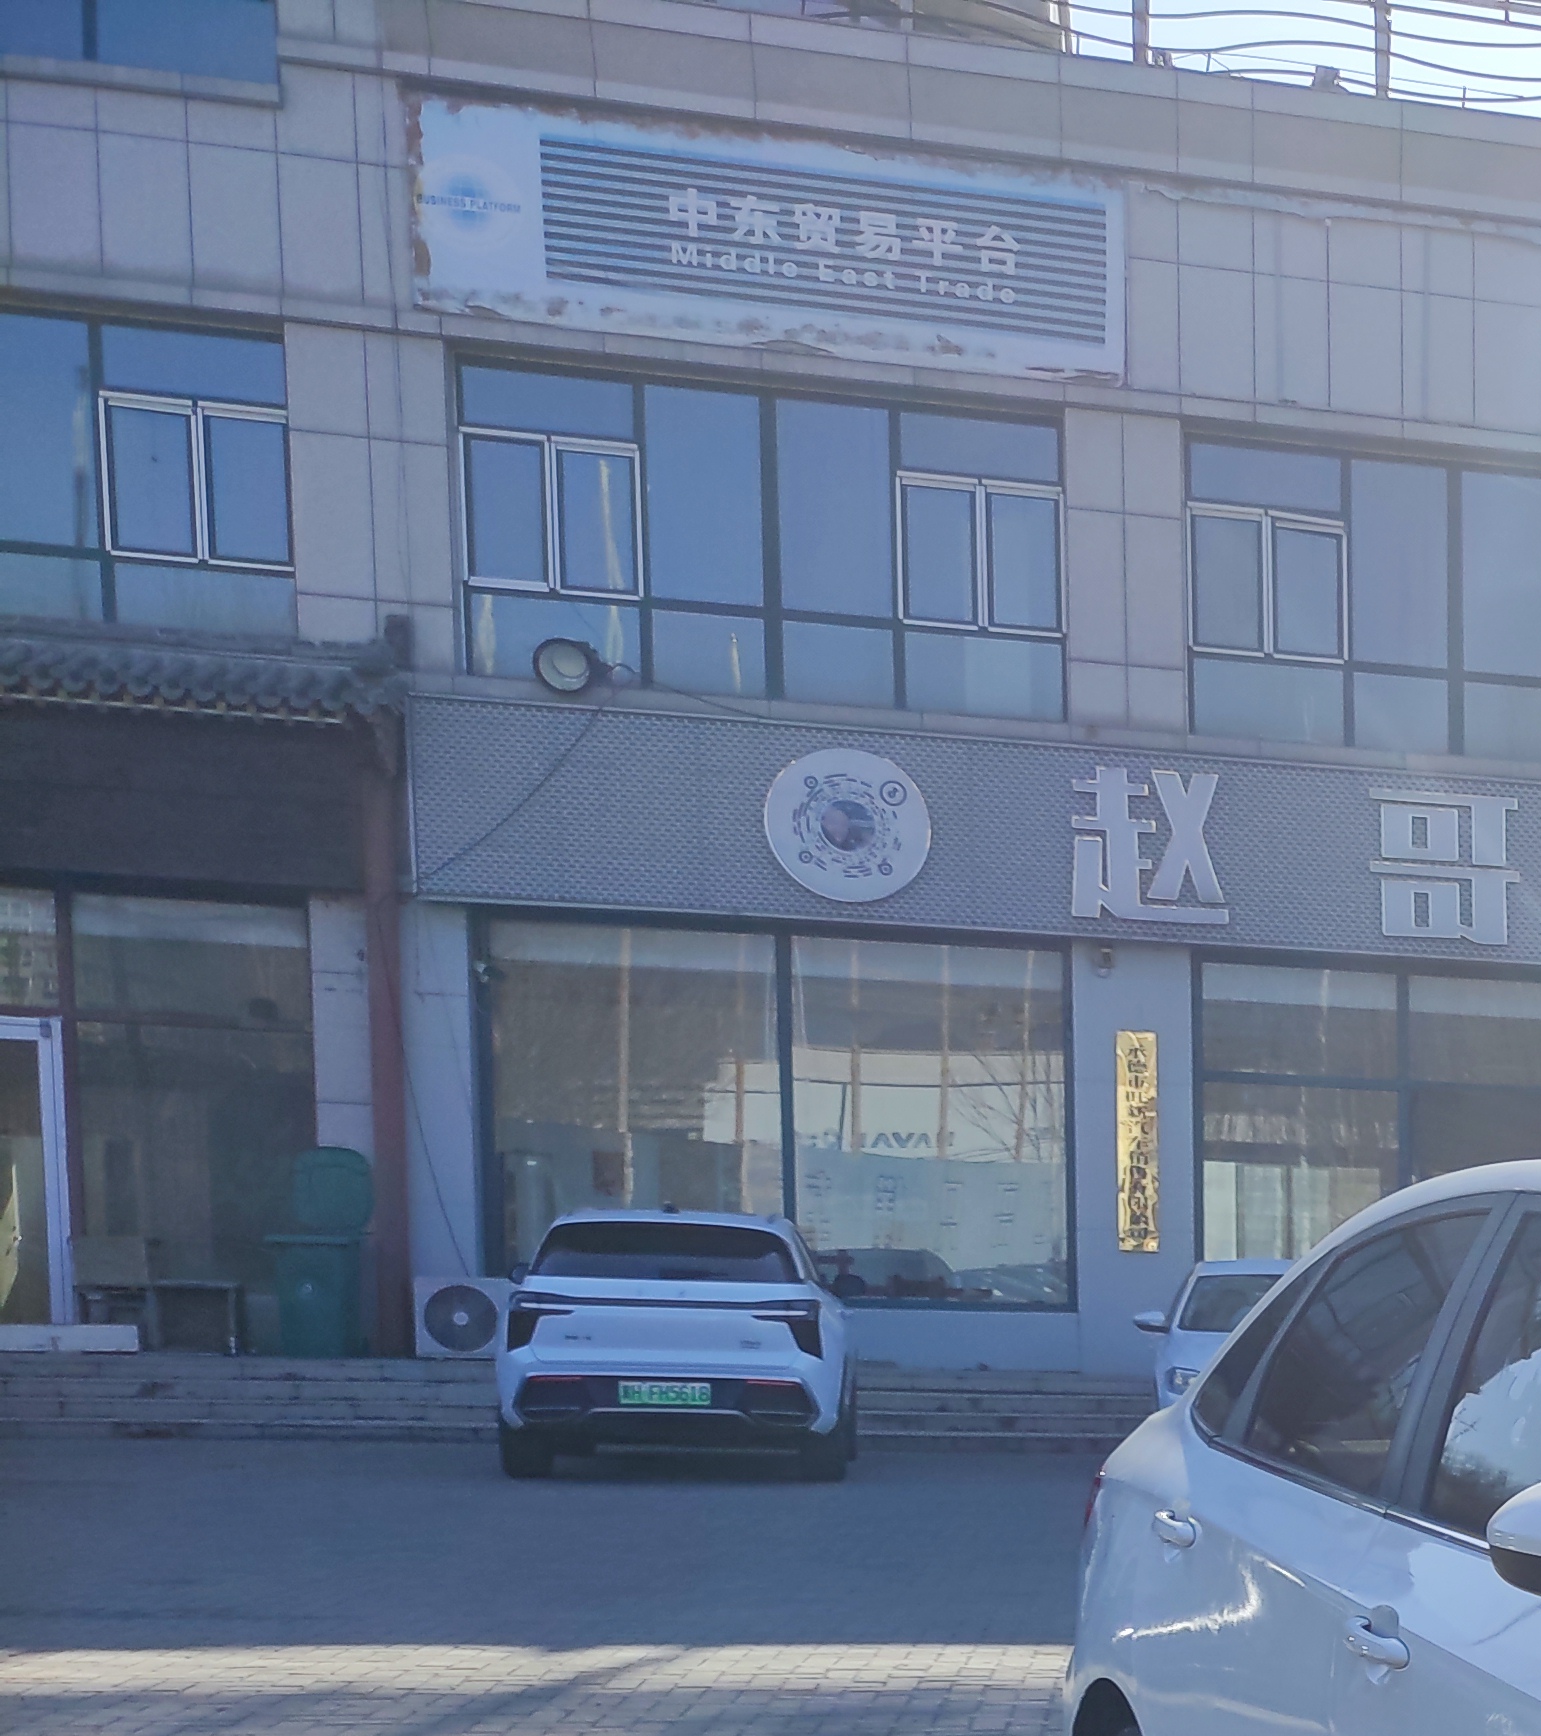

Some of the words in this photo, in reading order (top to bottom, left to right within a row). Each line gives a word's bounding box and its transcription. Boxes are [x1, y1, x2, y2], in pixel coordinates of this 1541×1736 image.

[469, 198, 521, 214] PLATFORM
[669, 187, 1021, 276] 中东贸易平台
[670, 239, 799, 279] Middle
[818, 258, 896, 291] East
[914, 271, 1018, 304] Trade
